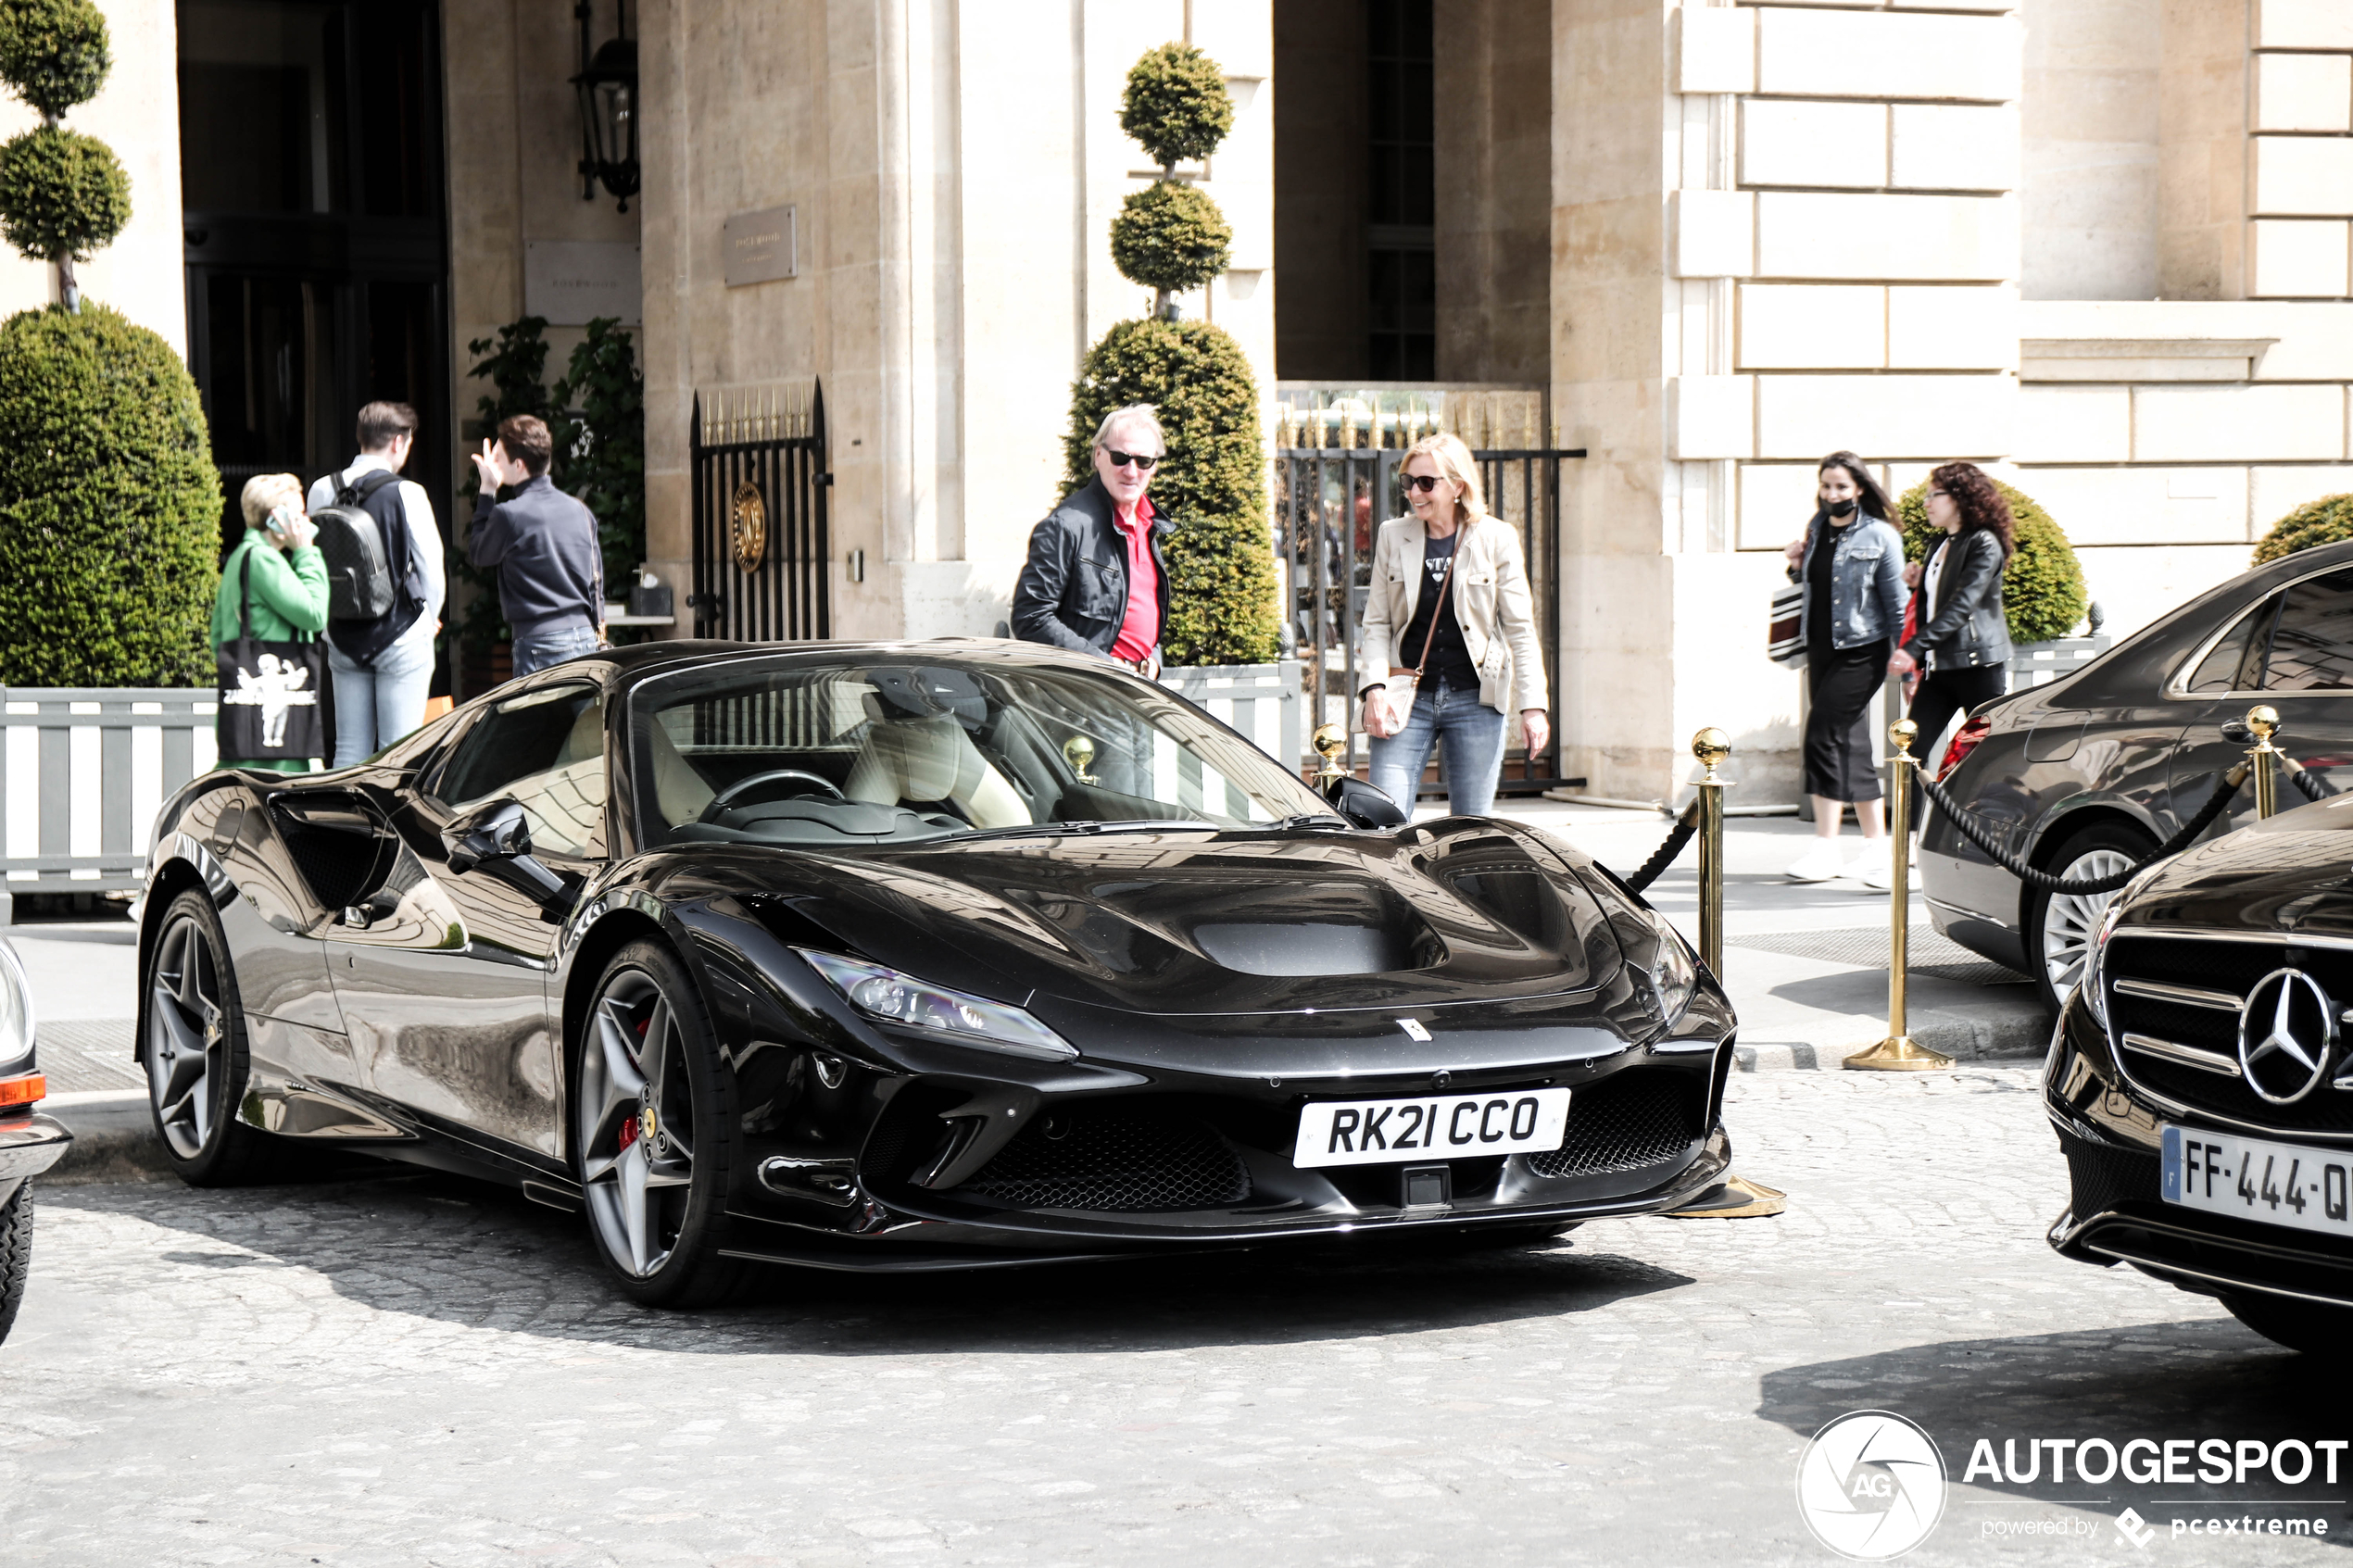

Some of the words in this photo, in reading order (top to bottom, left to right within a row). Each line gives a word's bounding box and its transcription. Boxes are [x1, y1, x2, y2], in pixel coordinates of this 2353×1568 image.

[1327, 1104, 1438, 1153] RK21
[1449, 1097, 1539, 1145] CCO
[2168, 1172, 2175, 1187] F
[2186, 1140, 2353, 1221] FF-444-Q
